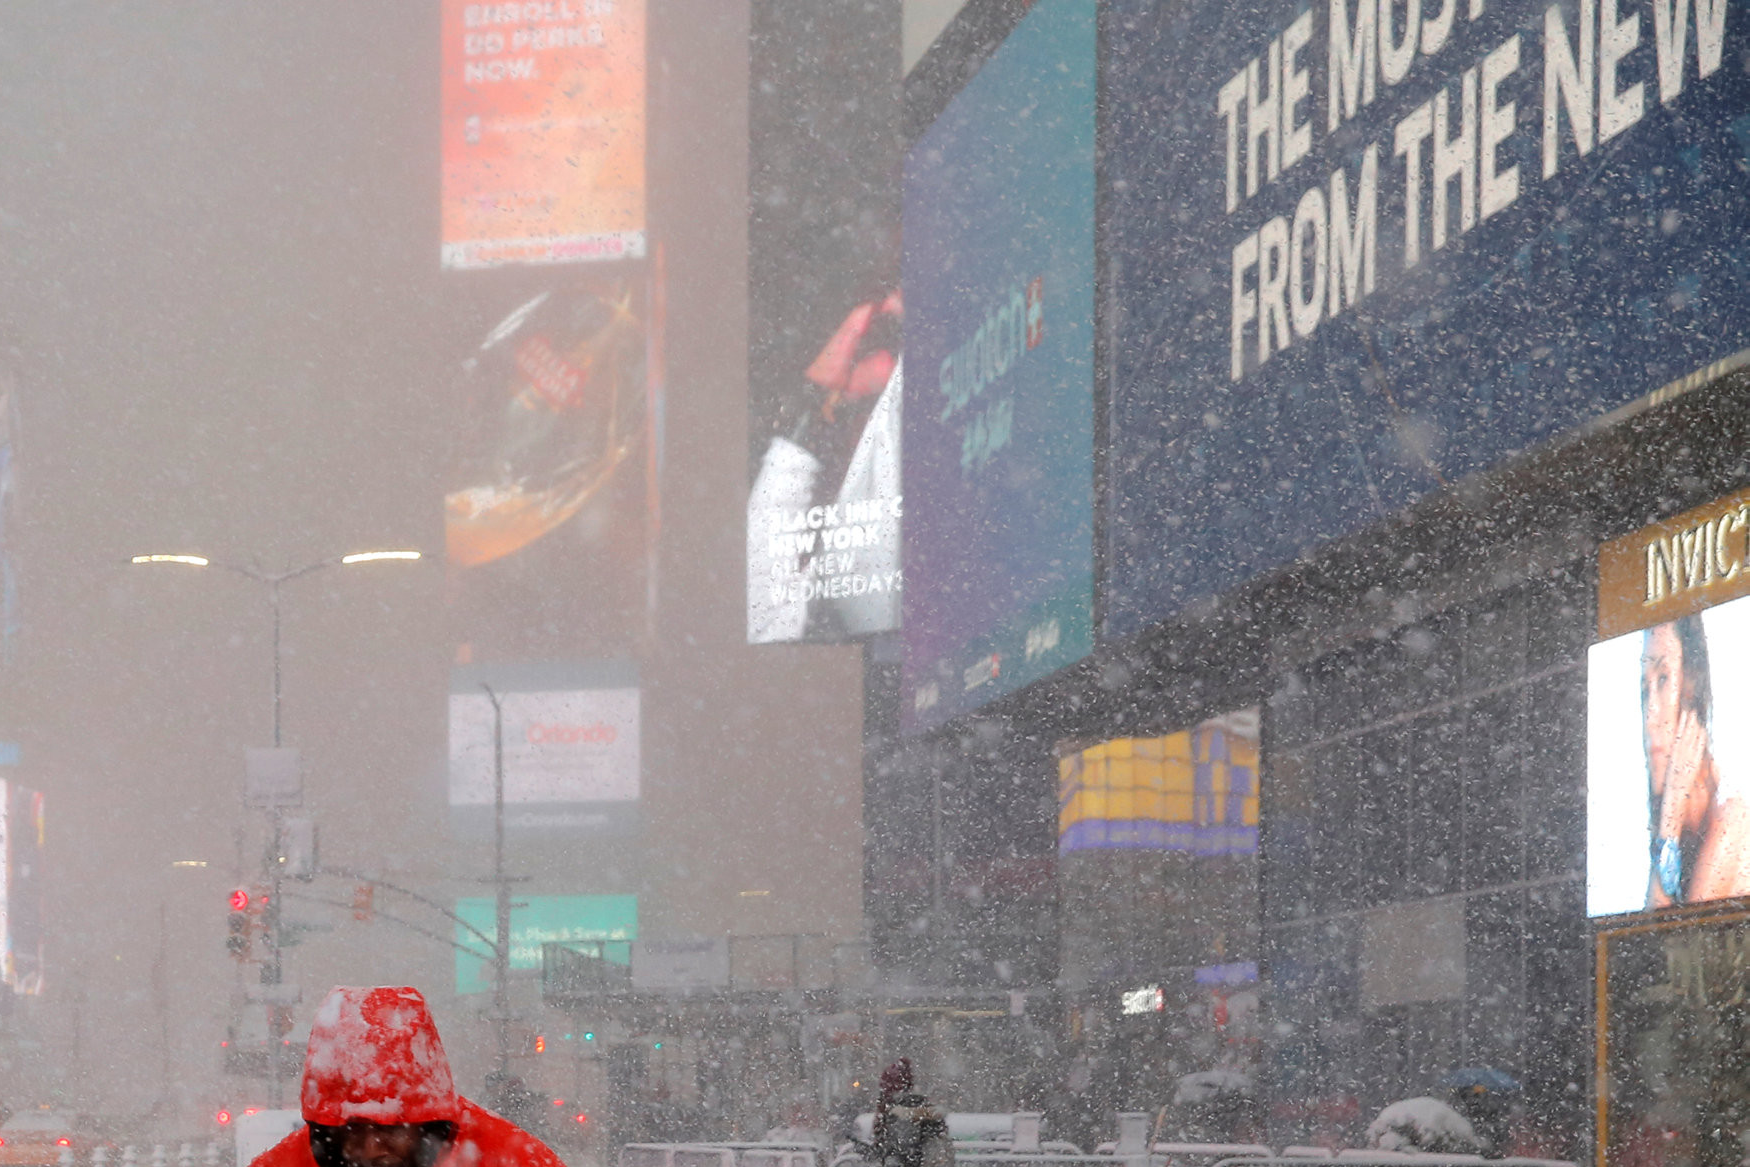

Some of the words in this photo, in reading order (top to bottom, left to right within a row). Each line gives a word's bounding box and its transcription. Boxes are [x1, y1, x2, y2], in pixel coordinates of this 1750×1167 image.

[1217, 9, 1313, 215] THE
[1230, 140, 1379, 383] FROM
[1394, 34, 1521, 270] THE
[768, 503, 840, 536] BLACK
[767, 530, 817, 558] NEW
[820, 524, 882, 551] YORK
[809, 551, 856, 576] NEW
[527, 720, 618, 744] Orlando
